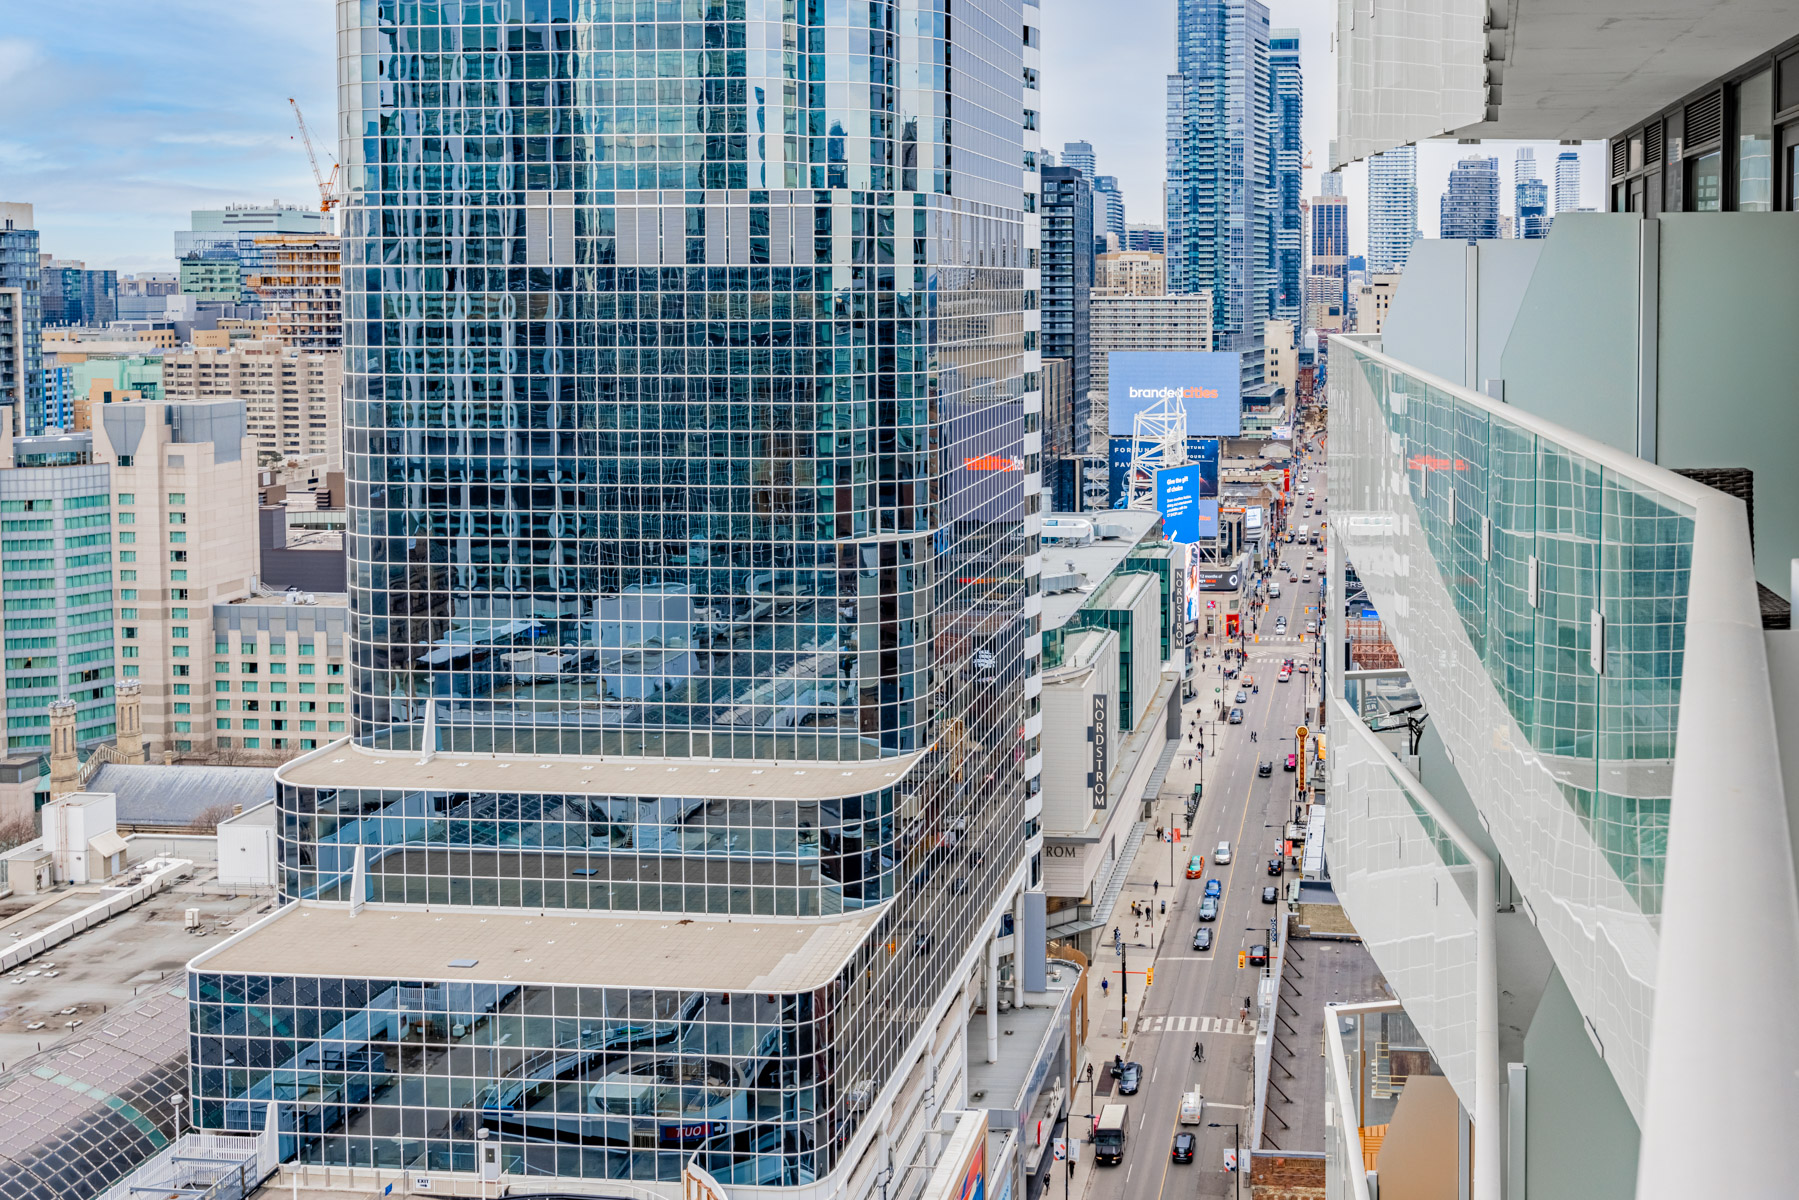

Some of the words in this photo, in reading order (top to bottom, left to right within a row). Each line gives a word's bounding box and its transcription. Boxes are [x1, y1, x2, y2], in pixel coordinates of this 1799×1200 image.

[1129, 386, 1219, 399] brandedcities
[1175, 571, 1184, 647] NORDSTROM
[1095, 698, 1105, 806] NORDSTROM
[1043, 845, 1076, 858] ROM
